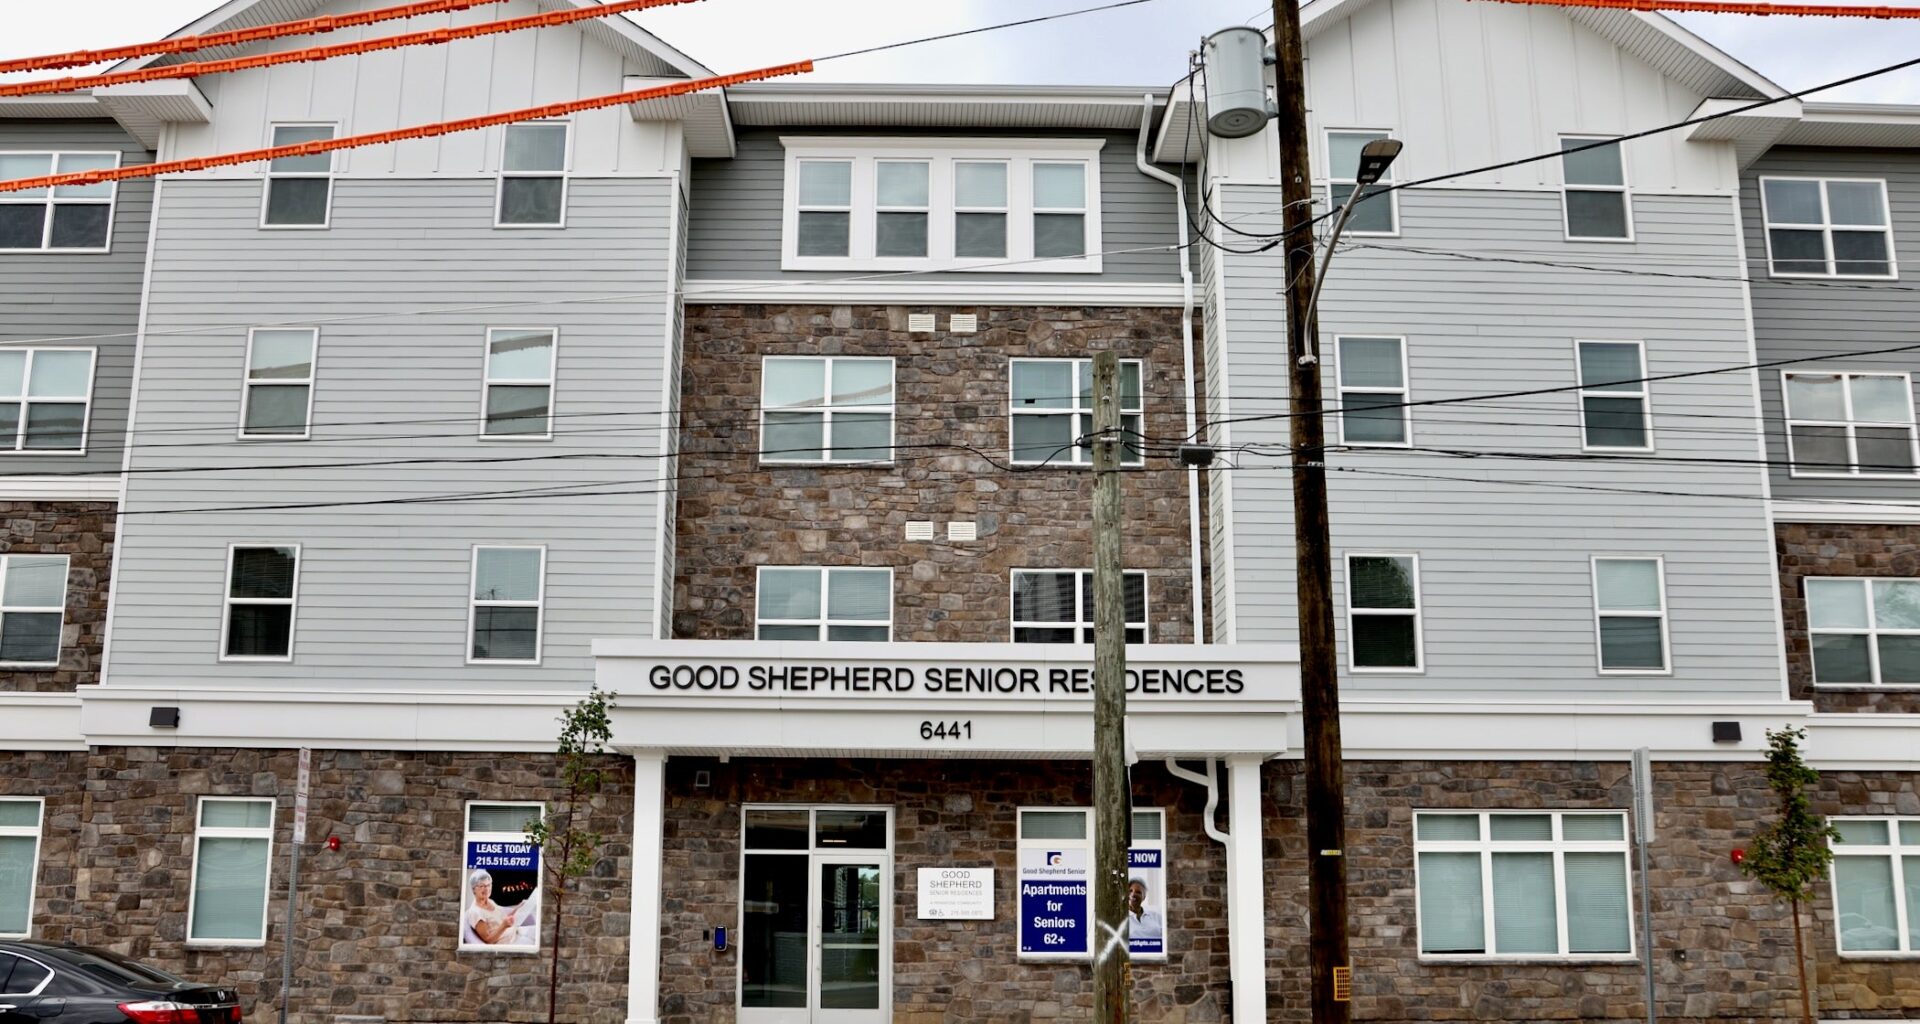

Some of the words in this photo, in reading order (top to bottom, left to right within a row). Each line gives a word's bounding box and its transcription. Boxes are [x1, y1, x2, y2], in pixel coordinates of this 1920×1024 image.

[649, 665, 739, 690] GOOD
[748, 666, 914, 692] SHEPHERD
[924, 668, 1040, 693] SENIOR
[1049, 669, 1244, 694] REDENCES
[920, 720, 972, 740] 6441
[476, 844, 502, 853] LEASE
[504, 844, 531, 854] TODAY
[476, 856, 531, 866] 215.515.6787
[1134, 852, 1157, 863] NOW
[941, 870, 971, 879] GOOD
[1022, 867, 1037, 875] Good
[1039, 867, 1066, 876] Shepherd
[929, 880, 982, 889] SHEPHERD
[1023, 883, 1087, 897] Apartments
[1046, 900, 1063, 912] for
[1034, 916, 1075, 928] Seniors
[1043, 933, 1066, 944] 62+
